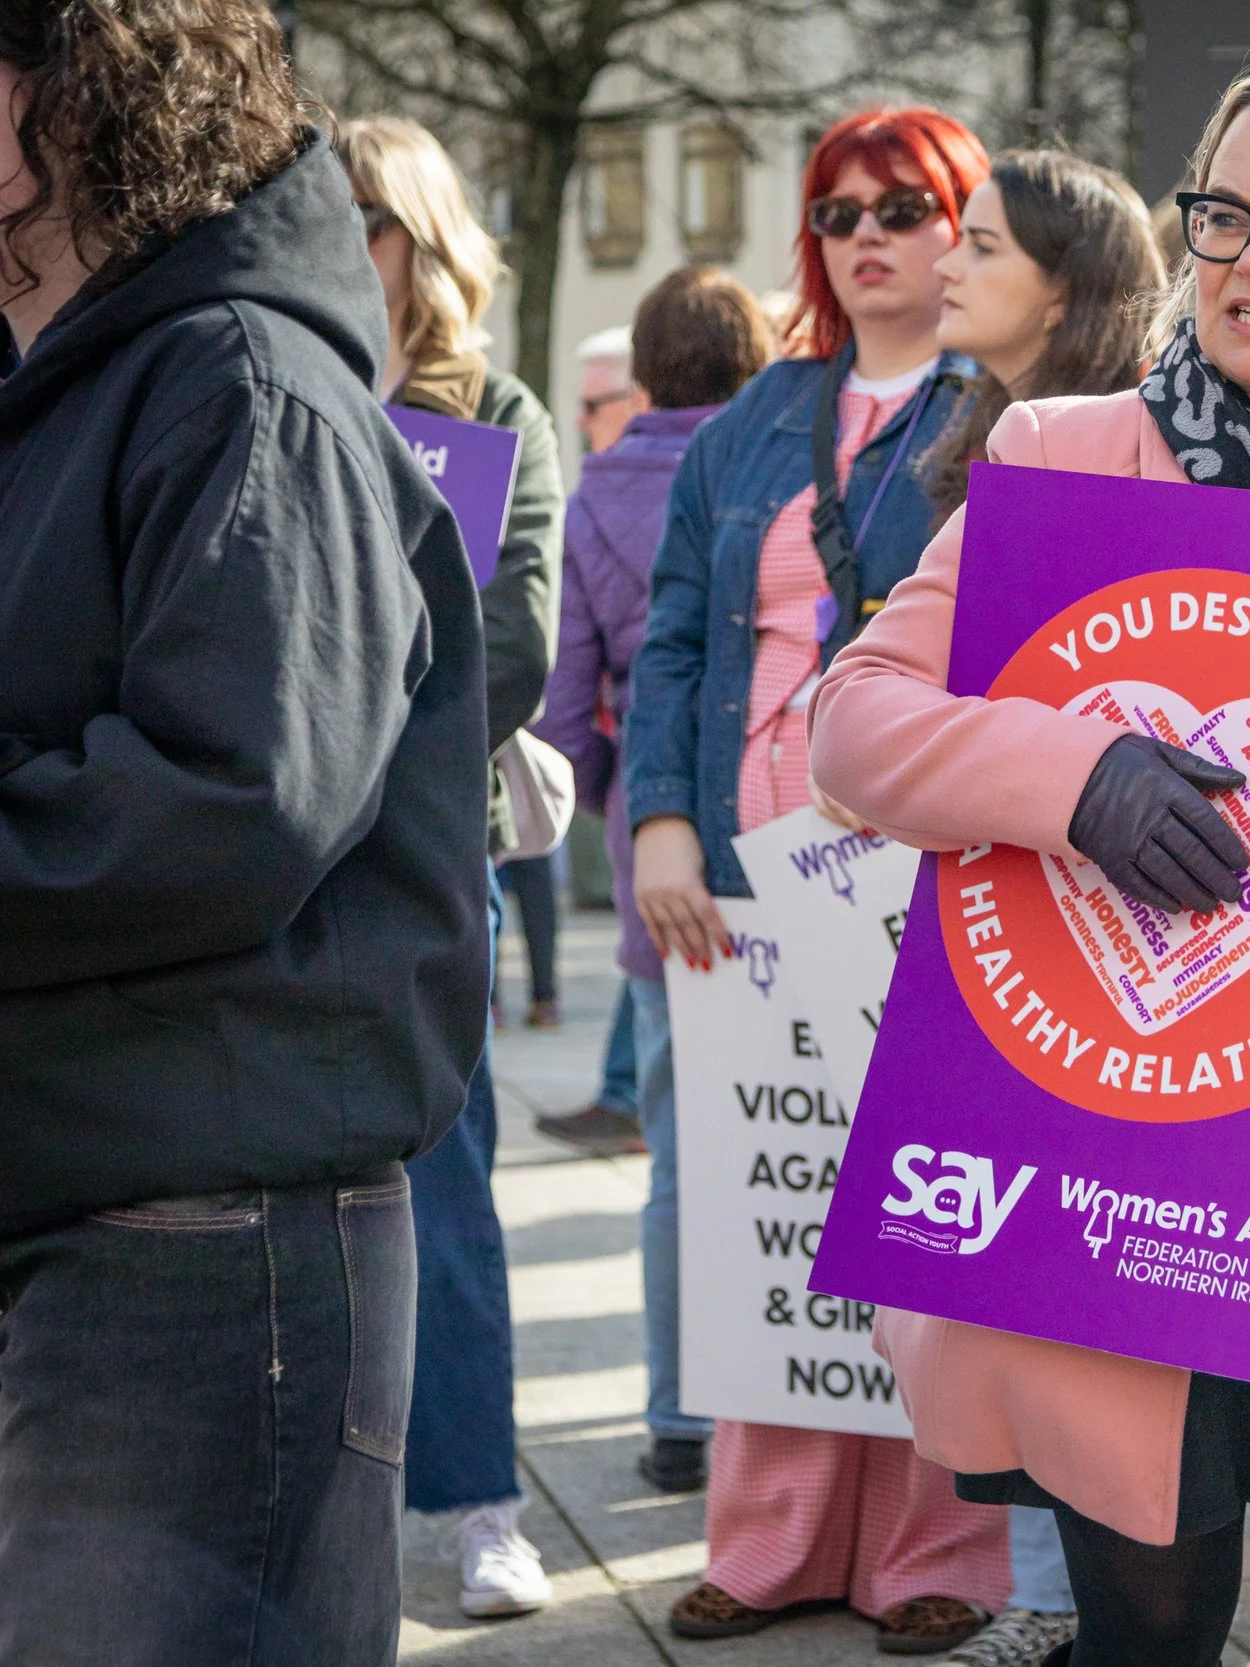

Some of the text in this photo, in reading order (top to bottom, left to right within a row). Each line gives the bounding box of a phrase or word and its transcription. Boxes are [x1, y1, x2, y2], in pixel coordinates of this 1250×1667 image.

[1048, 597, 1155, 672] YOU
[1185, 709, 1227, 748] LOYALTY
[960, 880, 1096, 1069] HEALTHY
[881, 1143, 1039, 1255] say
[1061, 1174, 1228, 1240] Women's
[886, 1226, 949, 1249] SOCIAL ACTION YOUTH
[1122, 1235, 1249, 1277] FEDERATION
[1116, 1258, 1228, 1298] NORTHERN
[764, 1286, 796, 1326] &
